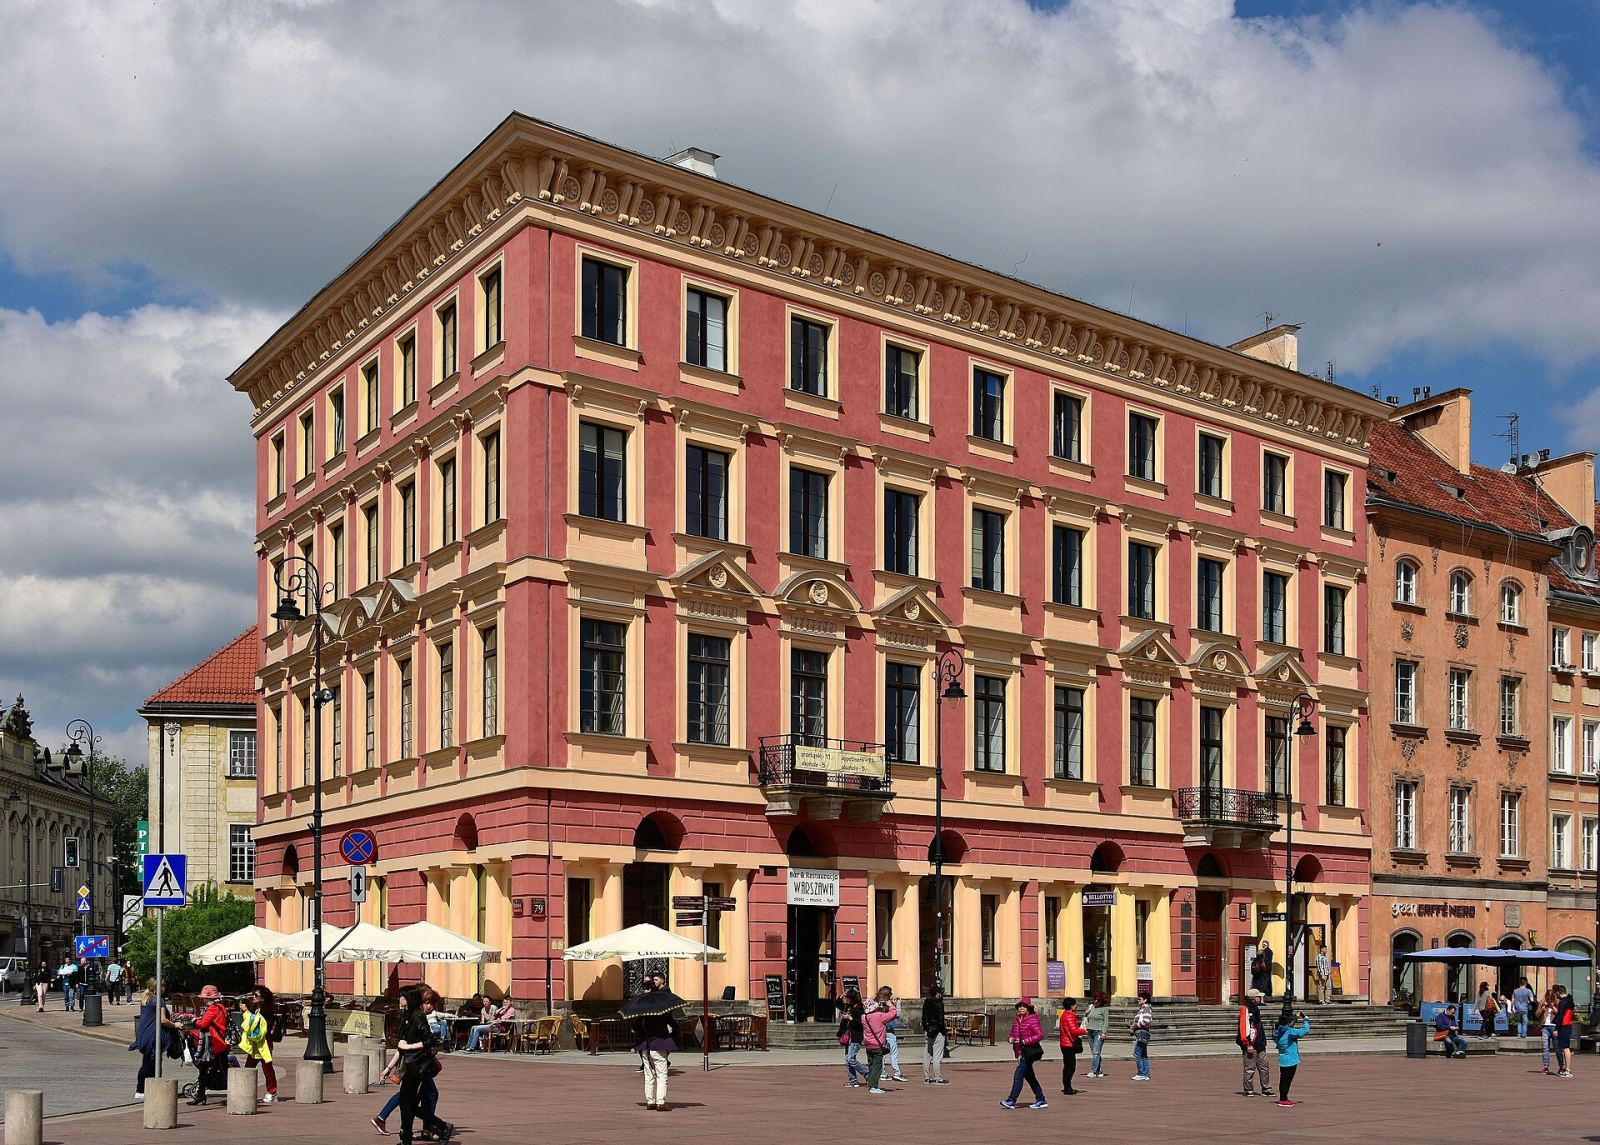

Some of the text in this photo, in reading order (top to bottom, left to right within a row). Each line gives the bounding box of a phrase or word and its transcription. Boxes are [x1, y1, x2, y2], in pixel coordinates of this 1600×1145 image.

[800, 871, 805, 879] &
[793, 881, 834, 896] WARSZAWA
[1449, 904, 1476, 919] NERO
[215, 952, 252, 962] CIECHAN
[420, 951, 466, 961] CIECHAN
